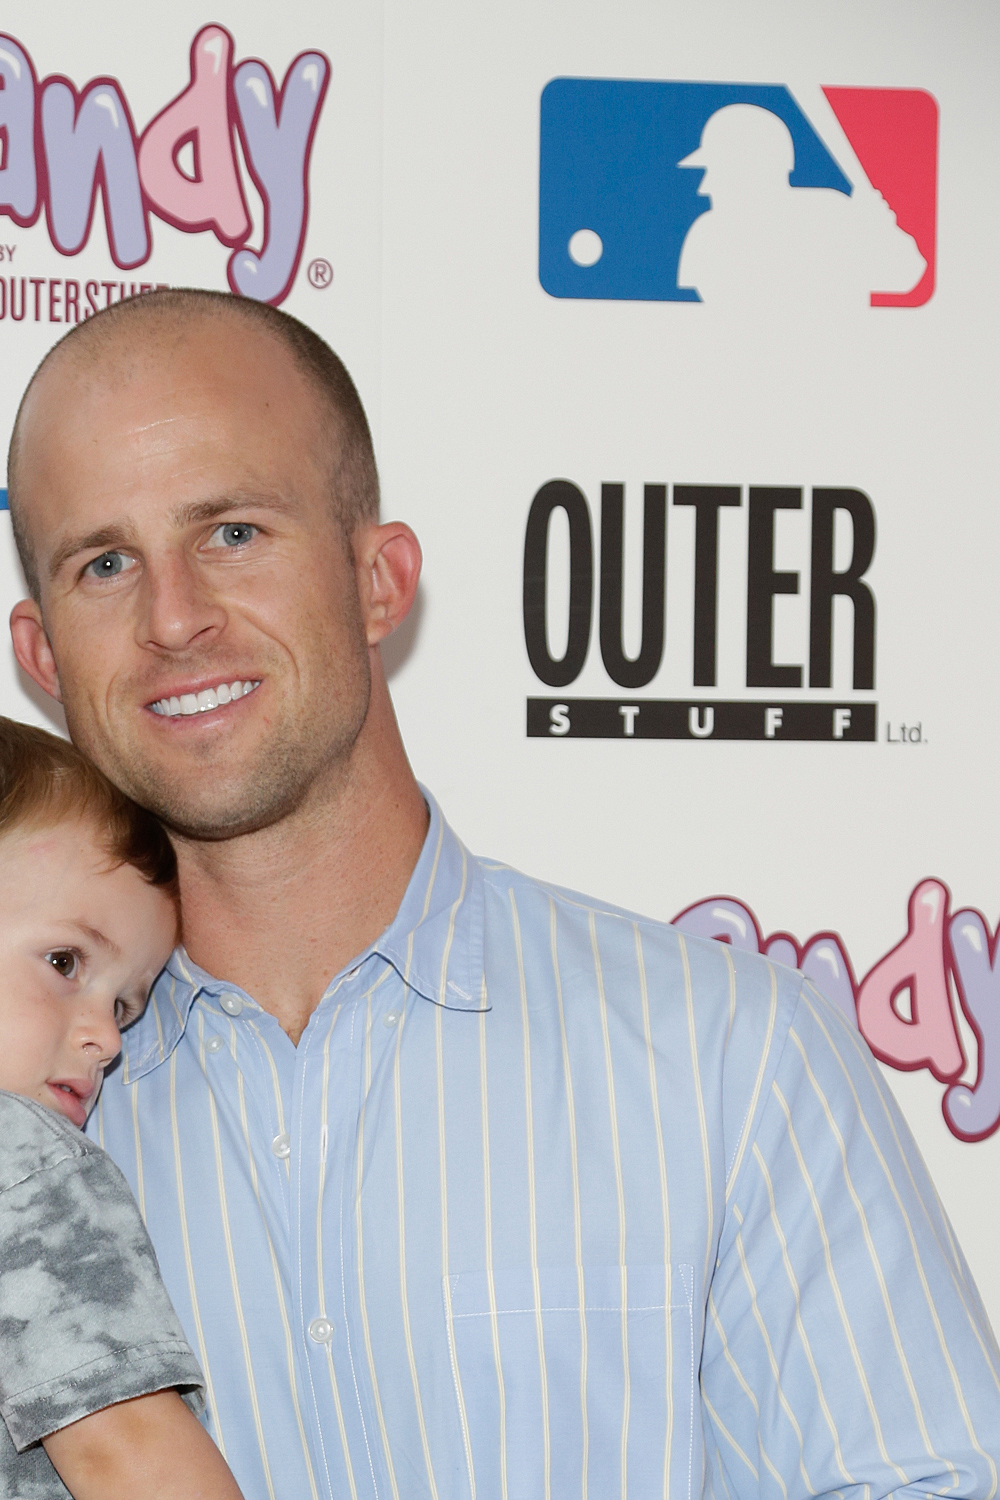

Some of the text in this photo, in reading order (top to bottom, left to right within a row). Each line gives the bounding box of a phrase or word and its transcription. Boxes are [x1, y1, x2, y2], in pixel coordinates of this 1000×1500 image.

[522, 477, 878, 690] OUTER
[548, 703, 929, 744] STUFF Ltd.
